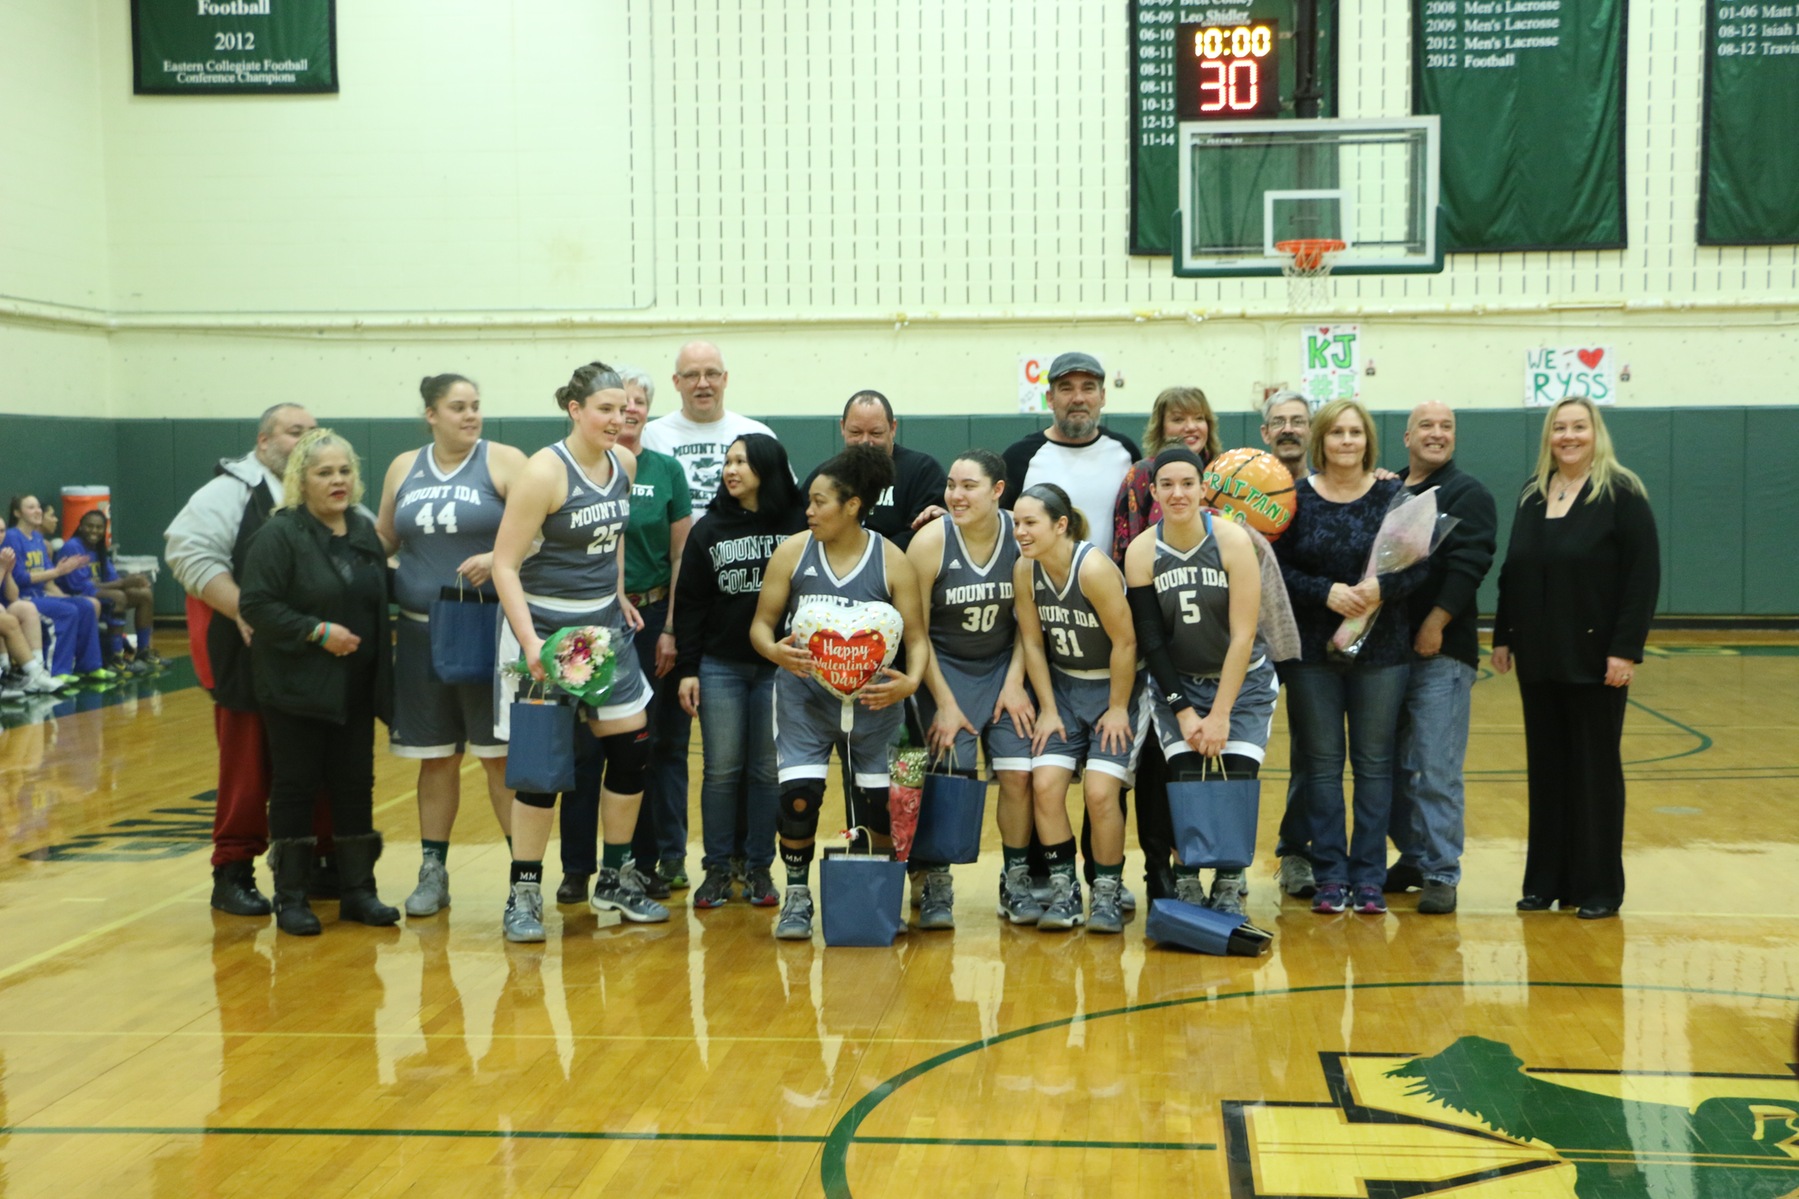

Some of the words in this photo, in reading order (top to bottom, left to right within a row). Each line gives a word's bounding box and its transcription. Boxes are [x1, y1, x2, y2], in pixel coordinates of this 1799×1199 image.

[197, 0, 271, 15] Football
[1180, 10, 1204, 23] Leo
[1426, 2, 1457, 14] 2008
[1464, 1, 1502, 14] Men's
[1504, 0, 1560, 12] Lacrosse
[1718, 4, 1759, 20] 01-06
[1761, 5, 1793, 18] Matt
[1139, 27, 1175, 41] 06-10
[1425, 19, 1457, 32] 2009
[1464, 18, 1501, 32] Men's
[1504, 17, 1560, 30] Lacrosse
[1718, 23, 1758, 38] 08-12
[1761, 23, 1793, 37] Isiah
[214, 31, 255, 51] 2012
[1194, 27, 1272, 59] 10:00
[1426, 36, 1457, 50] 2012
[1464, 36, 1501, 50] Men's
[1504, 35, 1560, 49] Lacrosse
[1717, 42, 1757, 56] 08-12
[163, 60, 204, 73] Eastern
[206, 59, 262, 74] Collegiate
[263, 58, 309, 72] Football
[1426, 53, 1457, 67] 2012
[1464, 53, 1516, 68] Football
[177, 72, 236, 84] Conference
[237, 71, 297, 85] Champions
[1200, 59, 1258, 112] 30
[1142, 98, 1175, 112] 10-13
[1142, 115, 1175, 129] 12-13
[1142, 132, 1175, 146] 11-14
[1308, 334, 1356, 369] KJ
[1527, 349, 1557, 370] WE
[1308, 374, 1356, 400] #5
[1534, 372, 1608, 403] RYSS
[673, 443, 717, 457] MOUNT
[401, 485, 453, 508] MOUNT
[454, 485, 482, 506] IDA
[415, 501, 459, 534] 44
[570, 501, 617, 529] MOUNT
[586, 522, 623, 555] 25
[709, 535, 774, 572] MOUNT
[719, 567, 763, 594] COLL
[1201, 567, 1229, 588] IDA
[945, 582, 996, 605] MOUNT
[998, 582, 1014, 599] ID
[1179, 590, 1201, 624] 5
[961, 604, 1000, 632] 30
[1072, 609, 1100, 628] IDA
[823, 638, 870, 660] Happy
[1050, 627, 1084, 658] 31
[813, 656, 879, 671] Valentine's
[830, 670, 864, 688] Day!
[520, 871, 537, 881] MM
